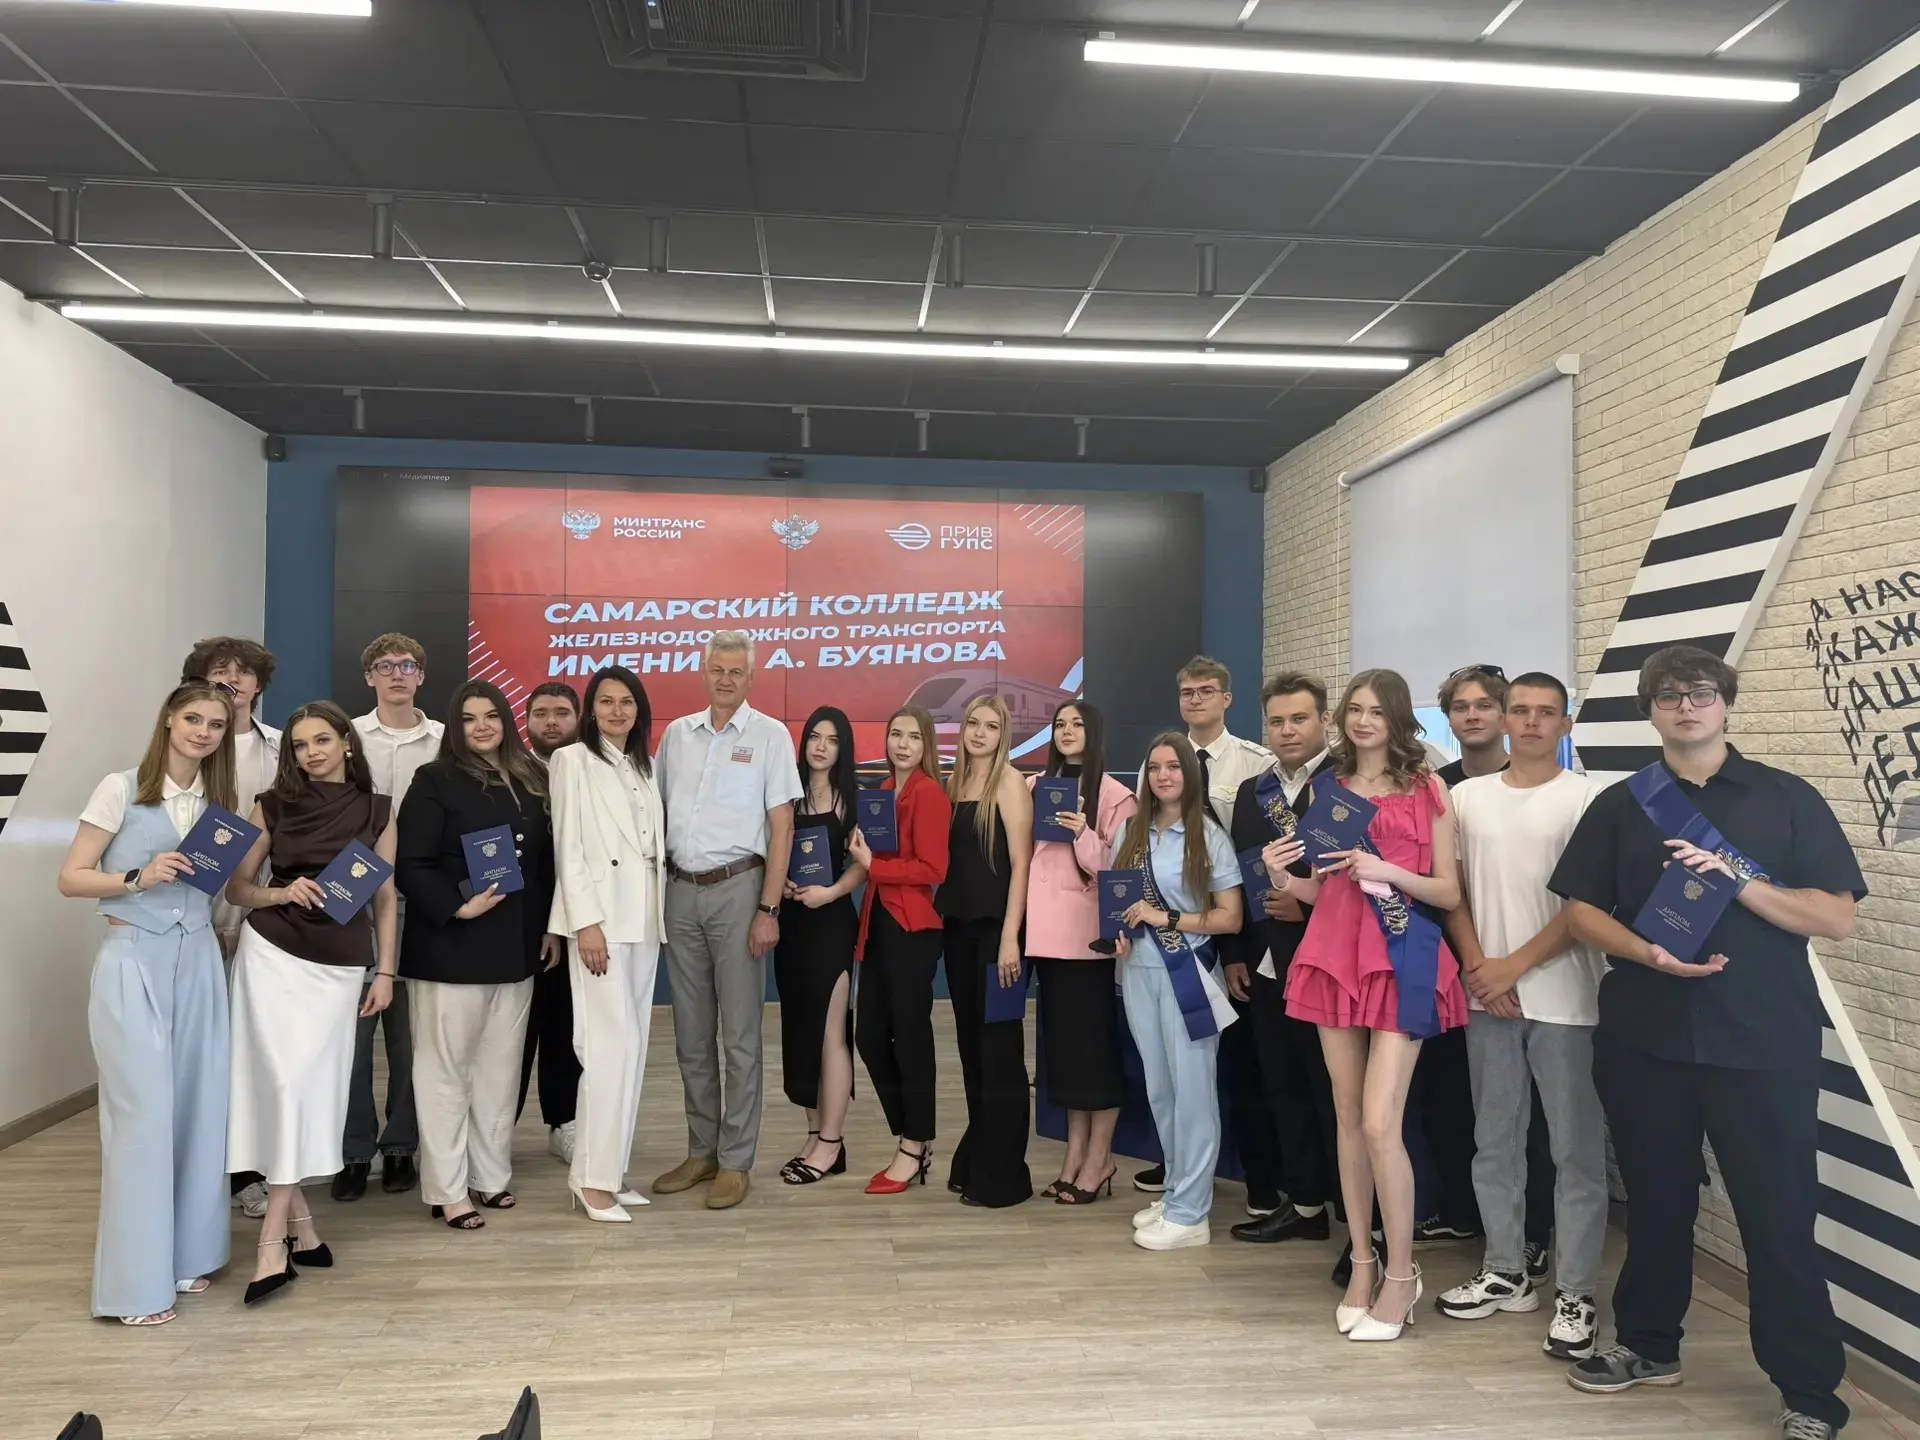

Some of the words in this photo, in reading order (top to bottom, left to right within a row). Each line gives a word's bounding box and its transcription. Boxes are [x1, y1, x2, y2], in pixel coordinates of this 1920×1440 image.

[399, 473, 450, 482] Медиаплеер
[613, 516, 706, 529] МИНТРАНС
[613, 528, 682, 539] РОССИИ
[940, 525, 993, 538] ПРИВ
[940, 537, 993, 550] ГУПС
[544, 592, 798, 624] САМАРСКИЙ
[809, 590, 1004, 616] КОЛЛЕДЖ
[846, 620, 1007, 638] ТРАНСПОРТА
[548, 651, 701, 677] ИМЕНИ
[764, 648, 806, 669] А.
[818, 640, 1007, 667] БУЯНОВА
[1662, 906, 1691, 927] ДИПЛОМ
